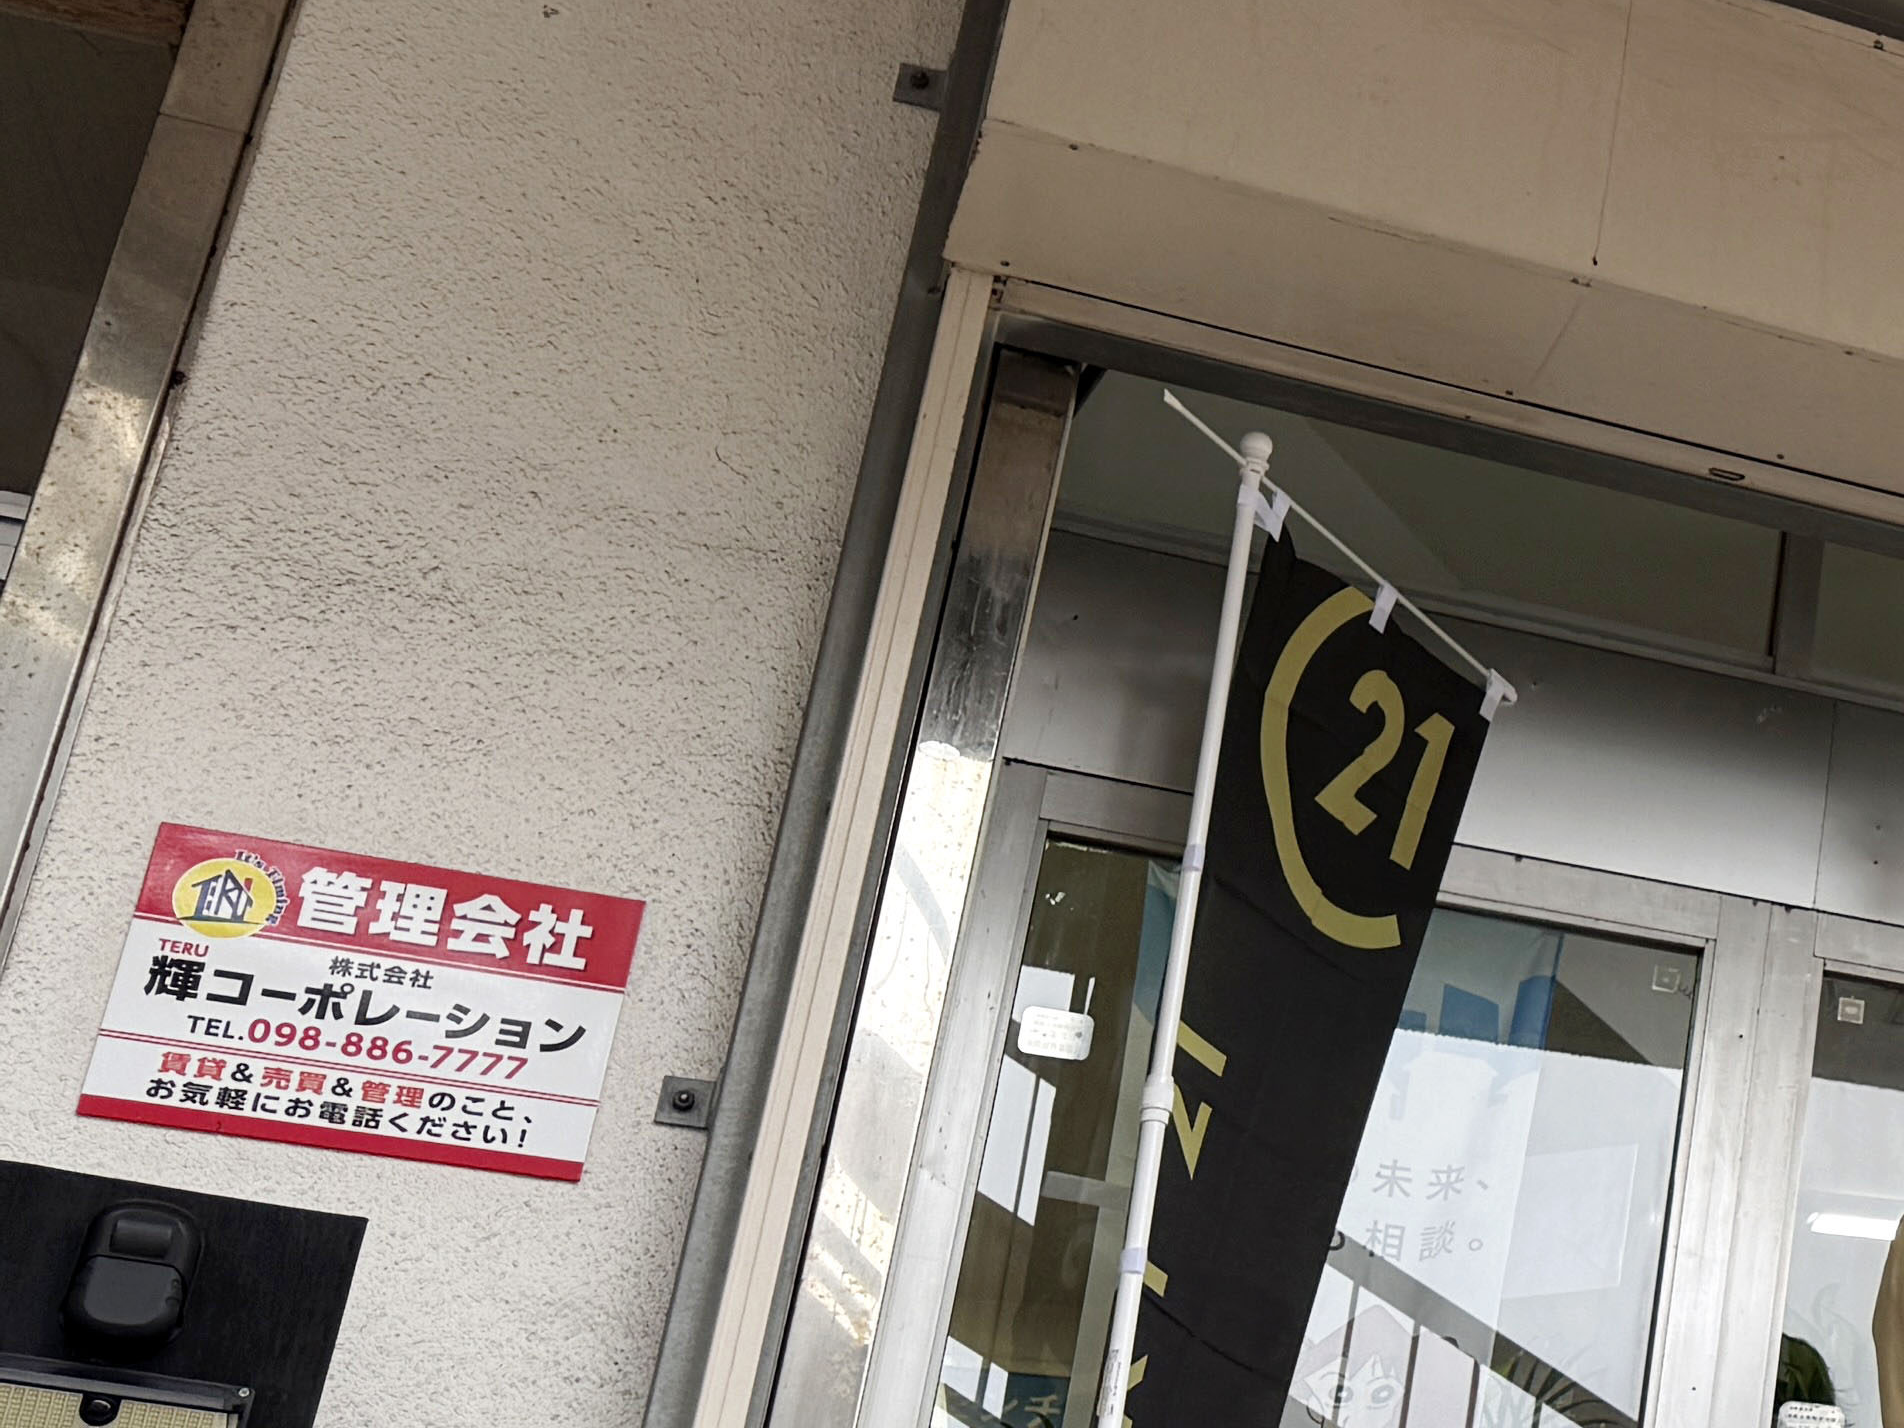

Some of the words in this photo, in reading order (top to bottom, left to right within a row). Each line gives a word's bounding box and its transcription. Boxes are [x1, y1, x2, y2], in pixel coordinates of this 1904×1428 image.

[297, 865, 598, 973] 管理会社
[158, 937, 210, 959] TERU
[328, 955, 435, 991] 株式会社
[143, 954, 587, 1056] 輝コーポレーション
[1352, 1158, 1490, 1202] 未来、
